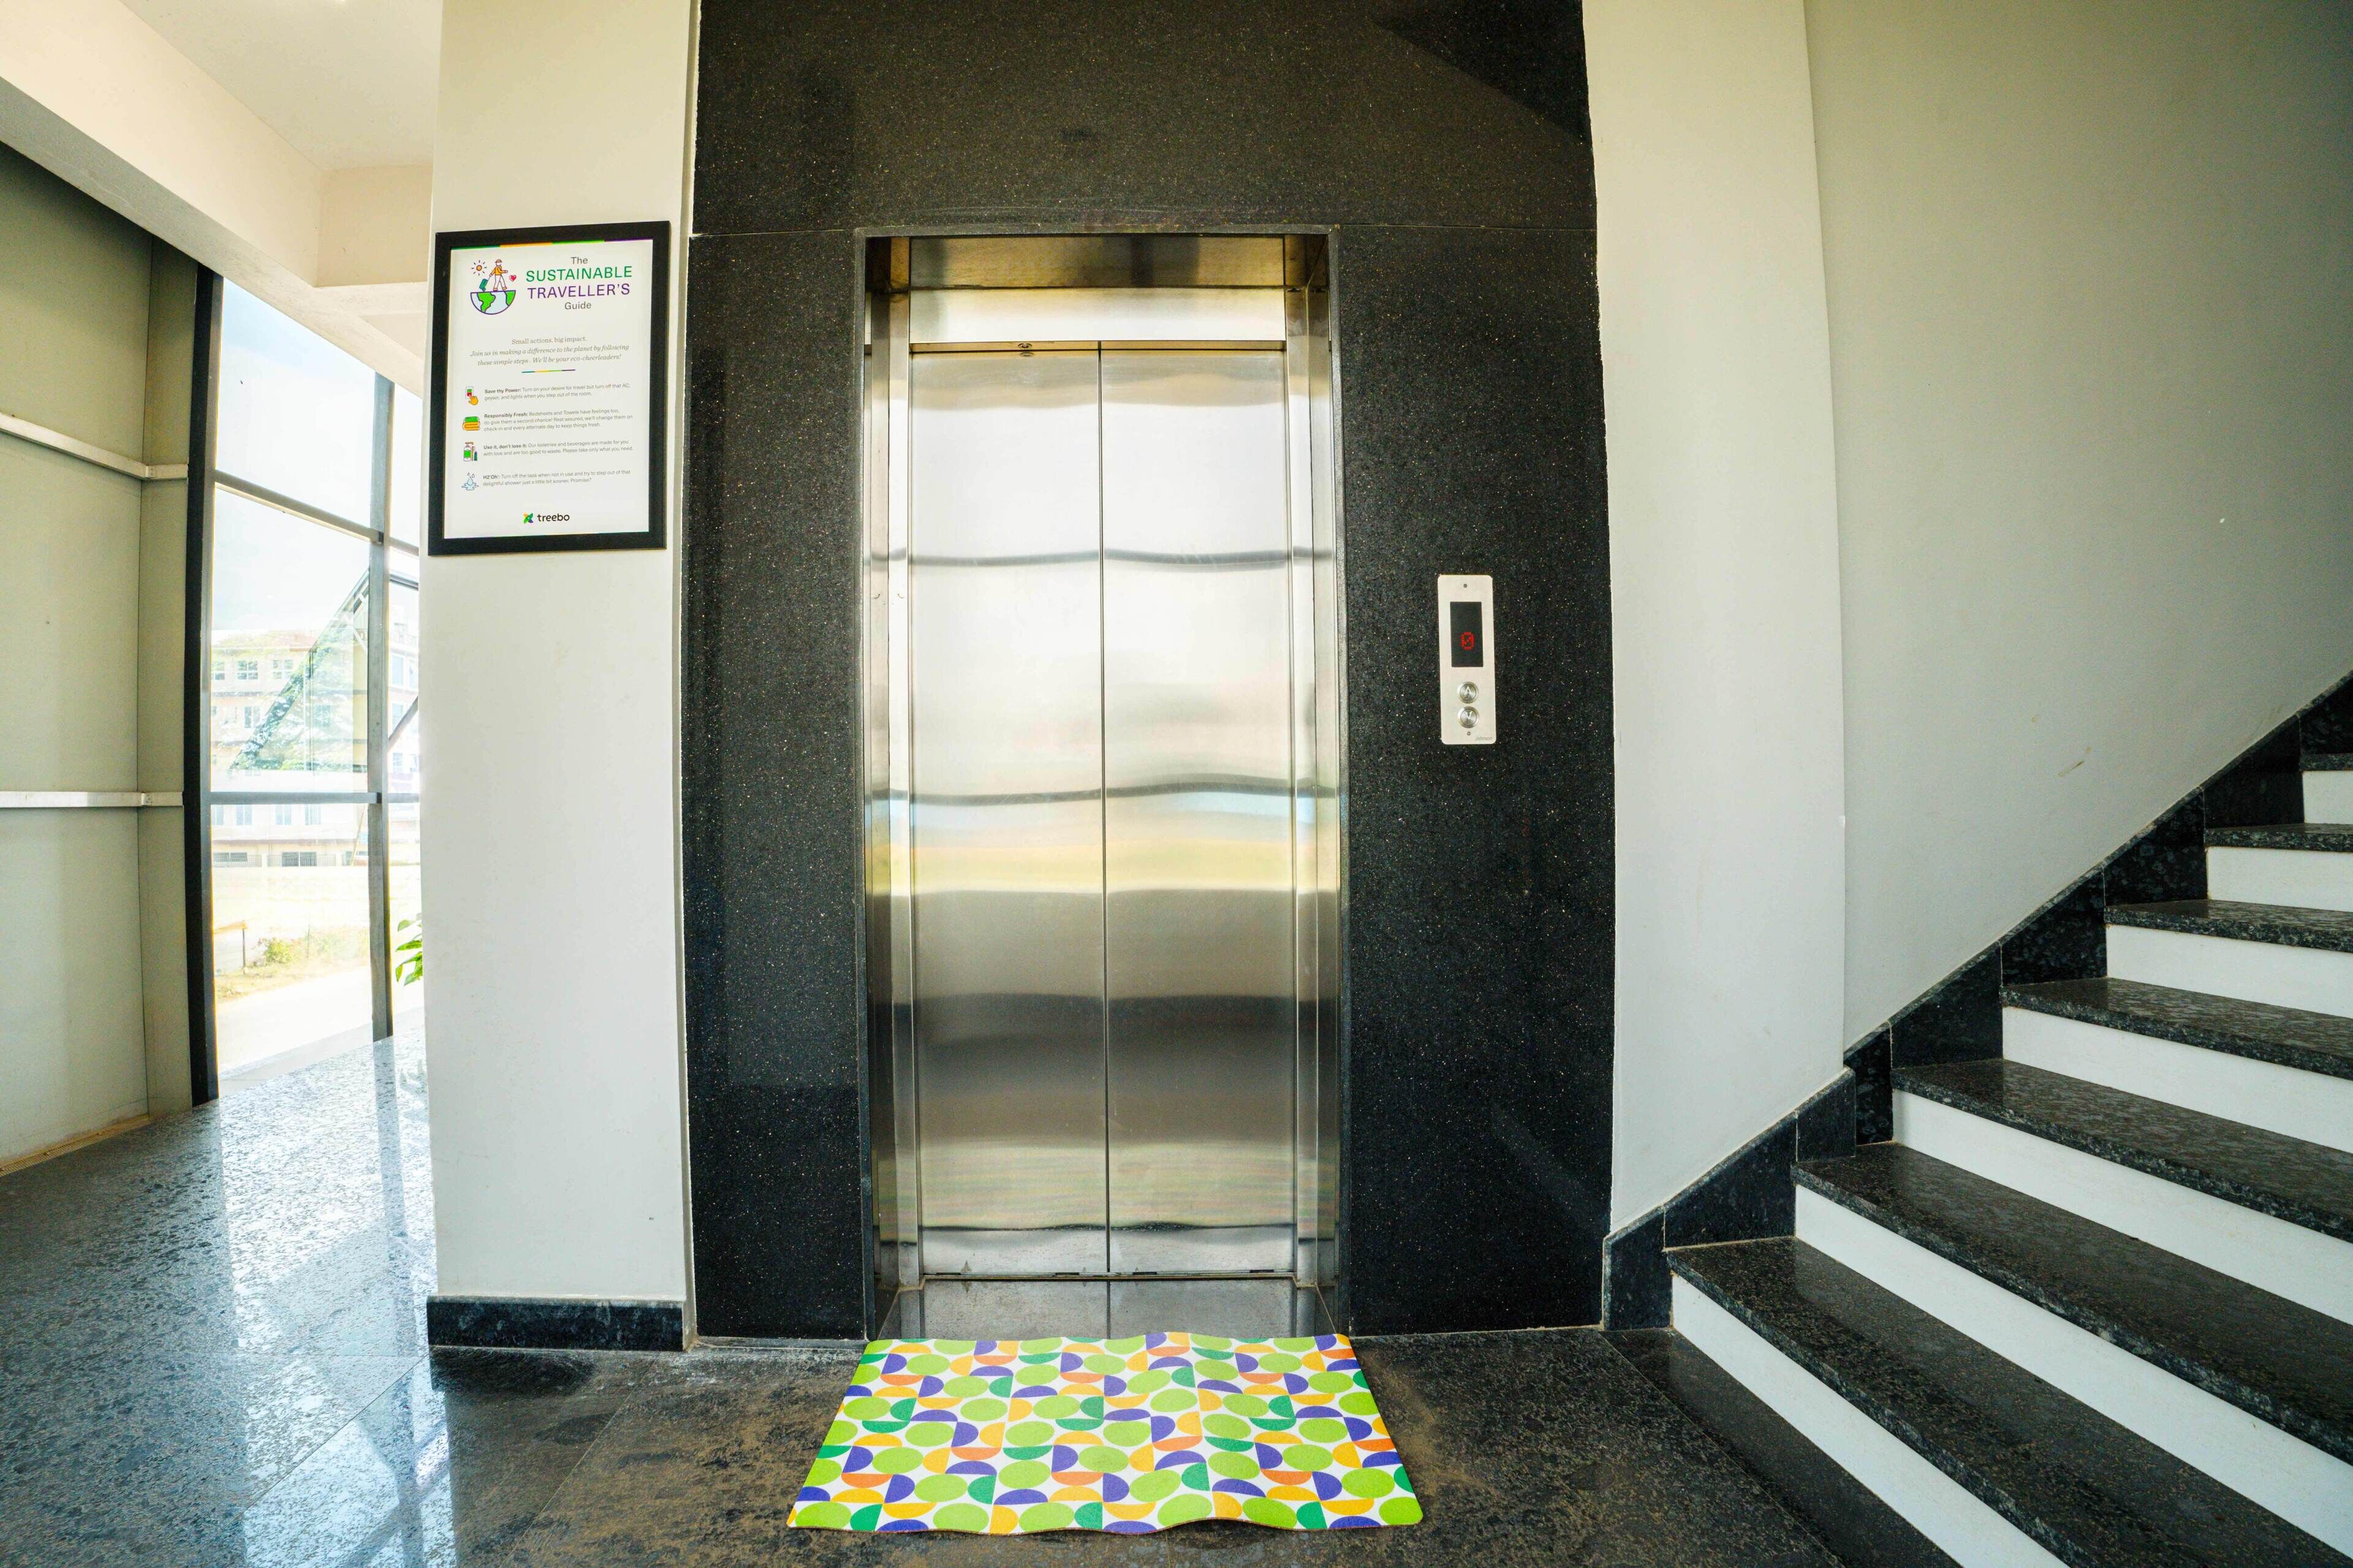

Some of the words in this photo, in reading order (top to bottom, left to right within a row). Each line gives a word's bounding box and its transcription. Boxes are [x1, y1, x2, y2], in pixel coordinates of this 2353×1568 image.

[526, 265, 632, 282] SUSTAINABLE
[527, 283, 630, 299] TRAVELLER'S
[564, 301, 592, 310] Guide
[564, 335, 587, 344] impact.
[537, 513, 570, 523] treebo
[1460, 631, 1474, 651] 0
